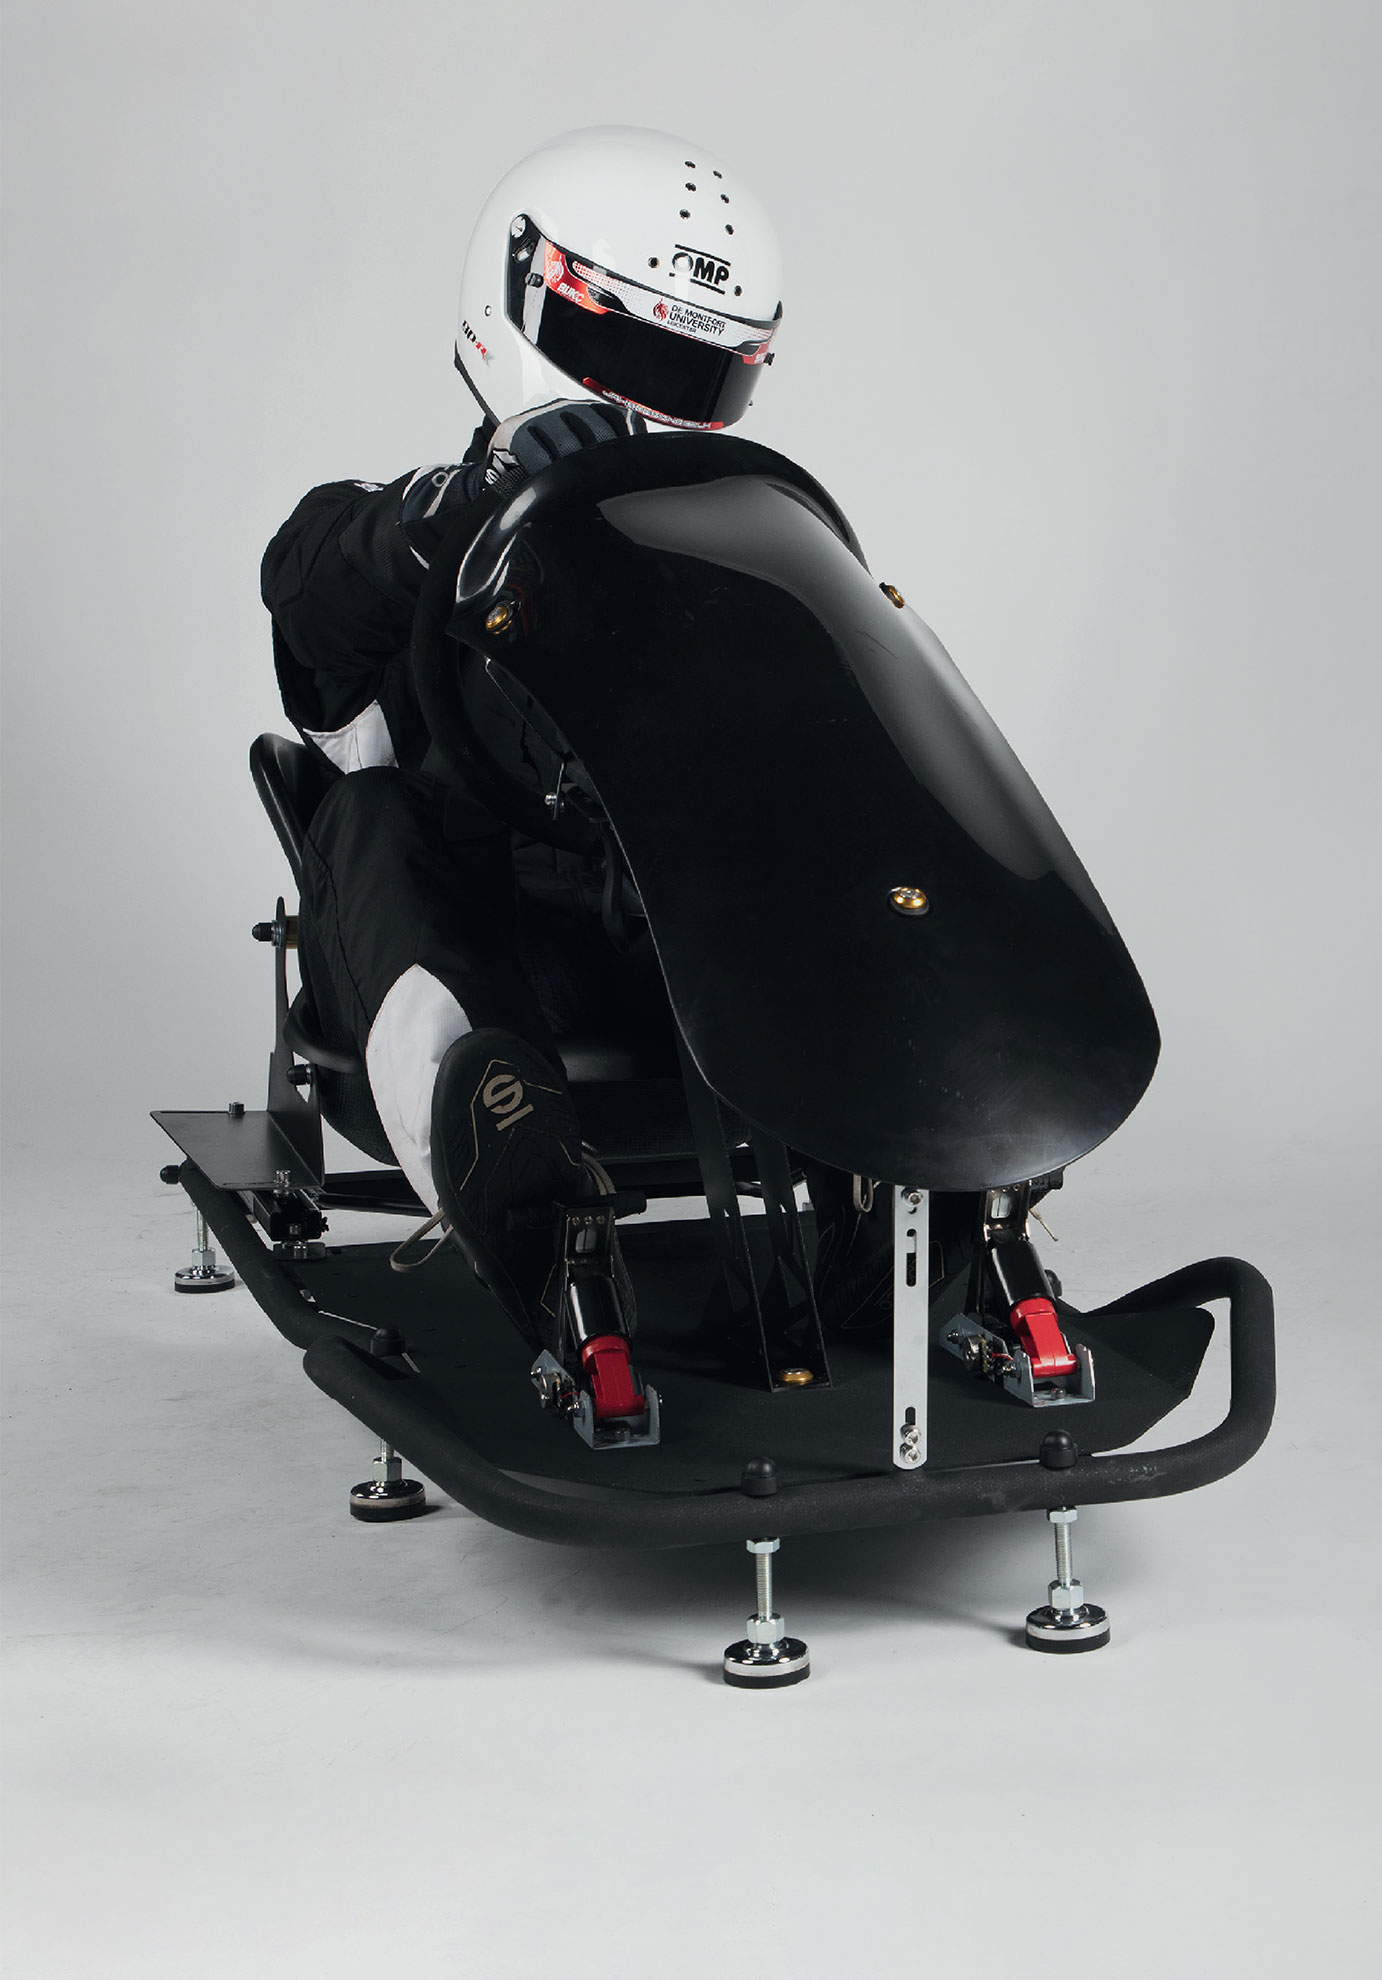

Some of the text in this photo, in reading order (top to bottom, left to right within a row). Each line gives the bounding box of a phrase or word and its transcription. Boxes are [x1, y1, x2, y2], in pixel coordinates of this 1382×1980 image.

[671, 251, 730, 286] OMP
[668, 312, 725, 336] UNIVERSITY
[671, 304, 727, 329] DE MONTFORT
